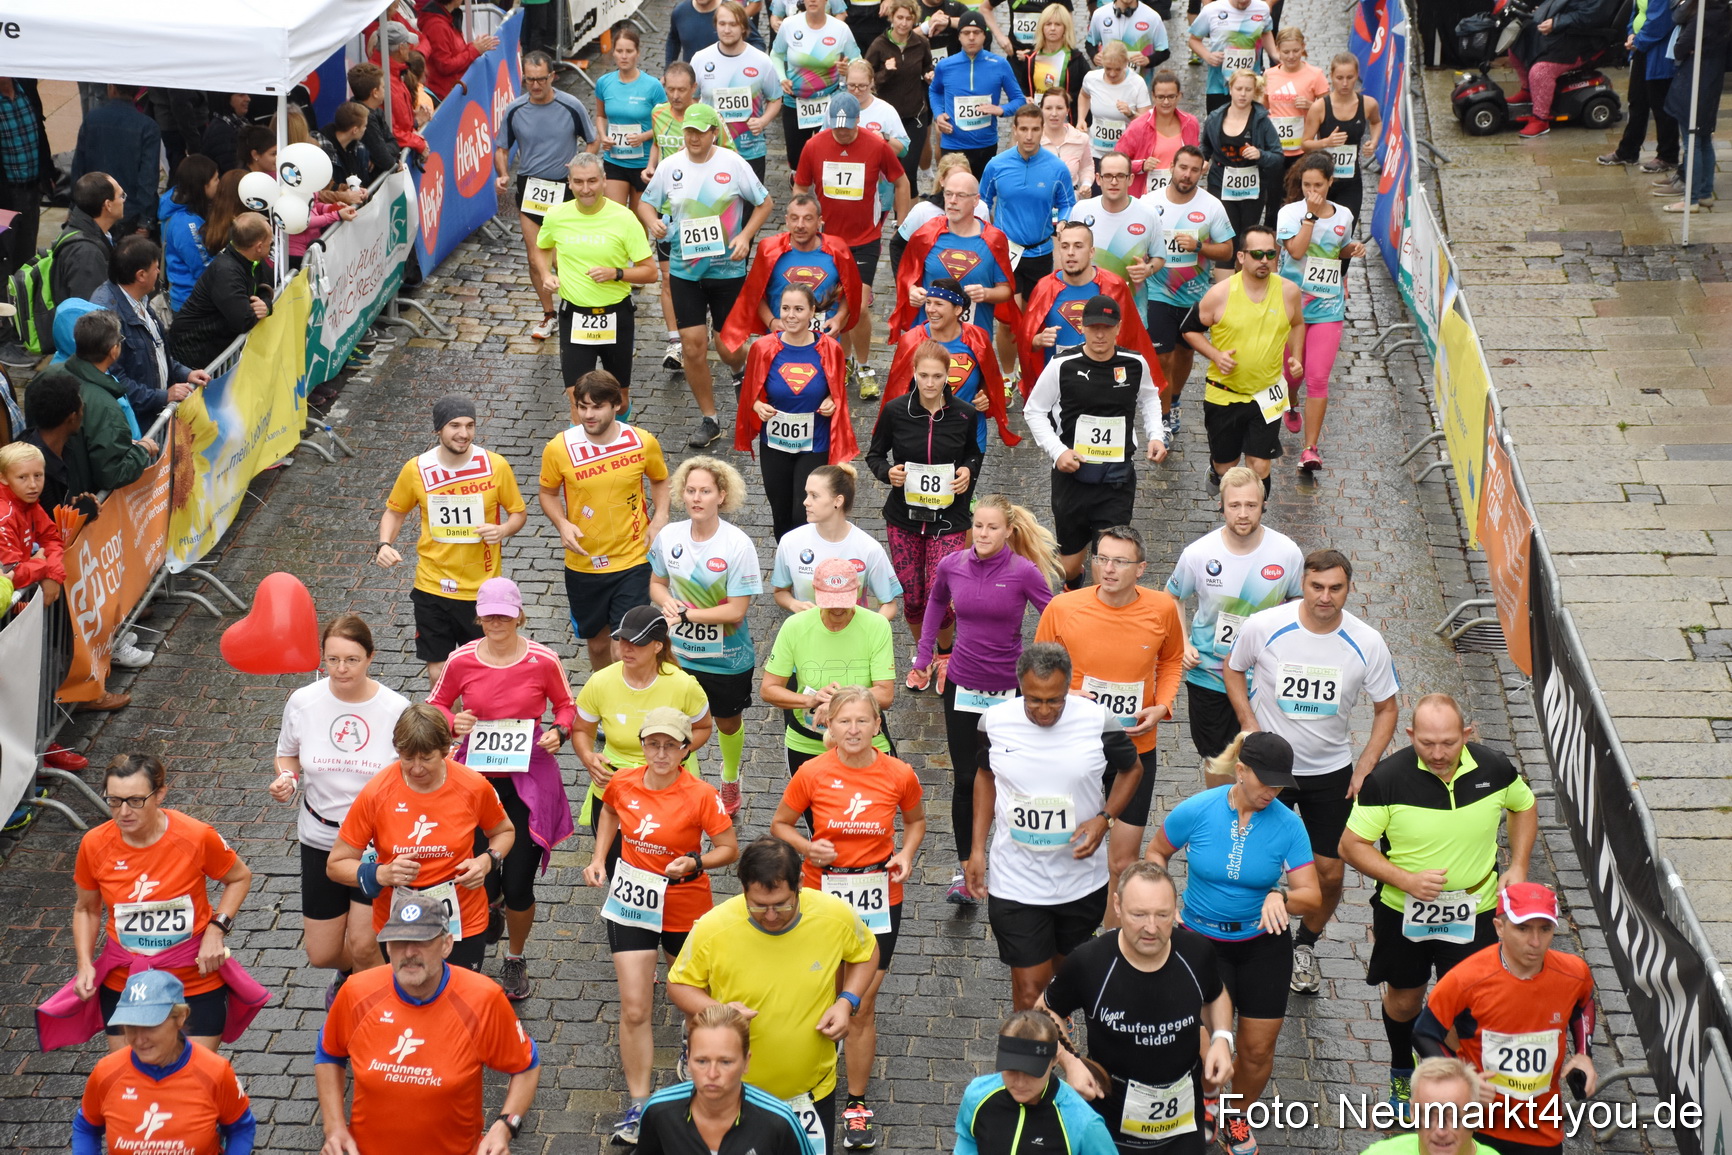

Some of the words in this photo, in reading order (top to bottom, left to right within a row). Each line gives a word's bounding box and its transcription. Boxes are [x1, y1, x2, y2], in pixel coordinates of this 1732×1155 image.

[1226, 58, 1254, 70] 2492
[718, 95, 750, 110] 2560
[1271, 93, 1297, 101] adida
[801, 102, 829, 117] 3047
[1095, 125, 1123, 140] 2908
[1278, 124, 1294, 138] 35
[456, 118, 492, 182] Hervis
[835, 171, 853, 187] 17
[1226, 174, 1257, 190] 2809
[532, 186, 556, 204] 291
[419, 171, 444, 240] Hervis
[683, 225, 719, 246] 2619
[694, 244, 711, 253] Frank
[1307, 266, 1340, 285] 2470
[581, 314, 609, 331] 228
[586, 332, 602, 340] Mark
[1268, 384, 1284, 402] 40
[771, 420, 809, 439] 2061
[1090, 428, 1112, 446] 34
[1087, 447, 1112, 457] Tomasz
[575, 463, 609, 481] MAX
[611, 453, 646, 471] BÖGL
[460, 480, 497, 496] BÖGL
[920, 474, 941, 493] 68
[439, 506, 473, 525] 311
[446, 528, 470, 538] Daniel
[1263, 568, 1283, 577] Hervis
[675, 621, 719, 643] 2265
[682, 641, 707, 654] Carina
[1282, 676, 1337, 702] 2913
[1293, 701, 1320, 714] Armin
[474, 731, 529, 752] 2032
[486, 755, 510, 767] Birgit
[826, 818, 880, 832] funrunners
[1012, 807, 1068, 831] 3071
[841, 827, 887, 838] neumarkt
[391, 843, 448, 855] funrunners
[623, 834, 668, 853] funrunners
[414, 850, 455, 860] eumarkt
[613, 875, 659, 911] 2330
[123, 908, 187, 933] 2625
[620, 906, 643, 921] Stilla
[1410, 901, 1478, 925] 2259
[137, 936, 174, 949] Christa
[1100, 1006, 1126, 1027] Vegan
[1112, 1020, 1156, 1035] Laufen
[1158, 1014, 1195, 1036] gegen
[1135, 1033, 1177, 1047] Leiden
[367, 1057, 434, 1077] funrunners
[1498, 1047, 1549, 1074] 280
[384, 1072, 443, 1087] neumarkt
[1508, 1078, 1538, 1091] Oliver
[1147, 1096, 1179, 1121] 28
[1140, 1119, 1180, 1135] Michael
[114, 1135, 186, 1151] funrunners
